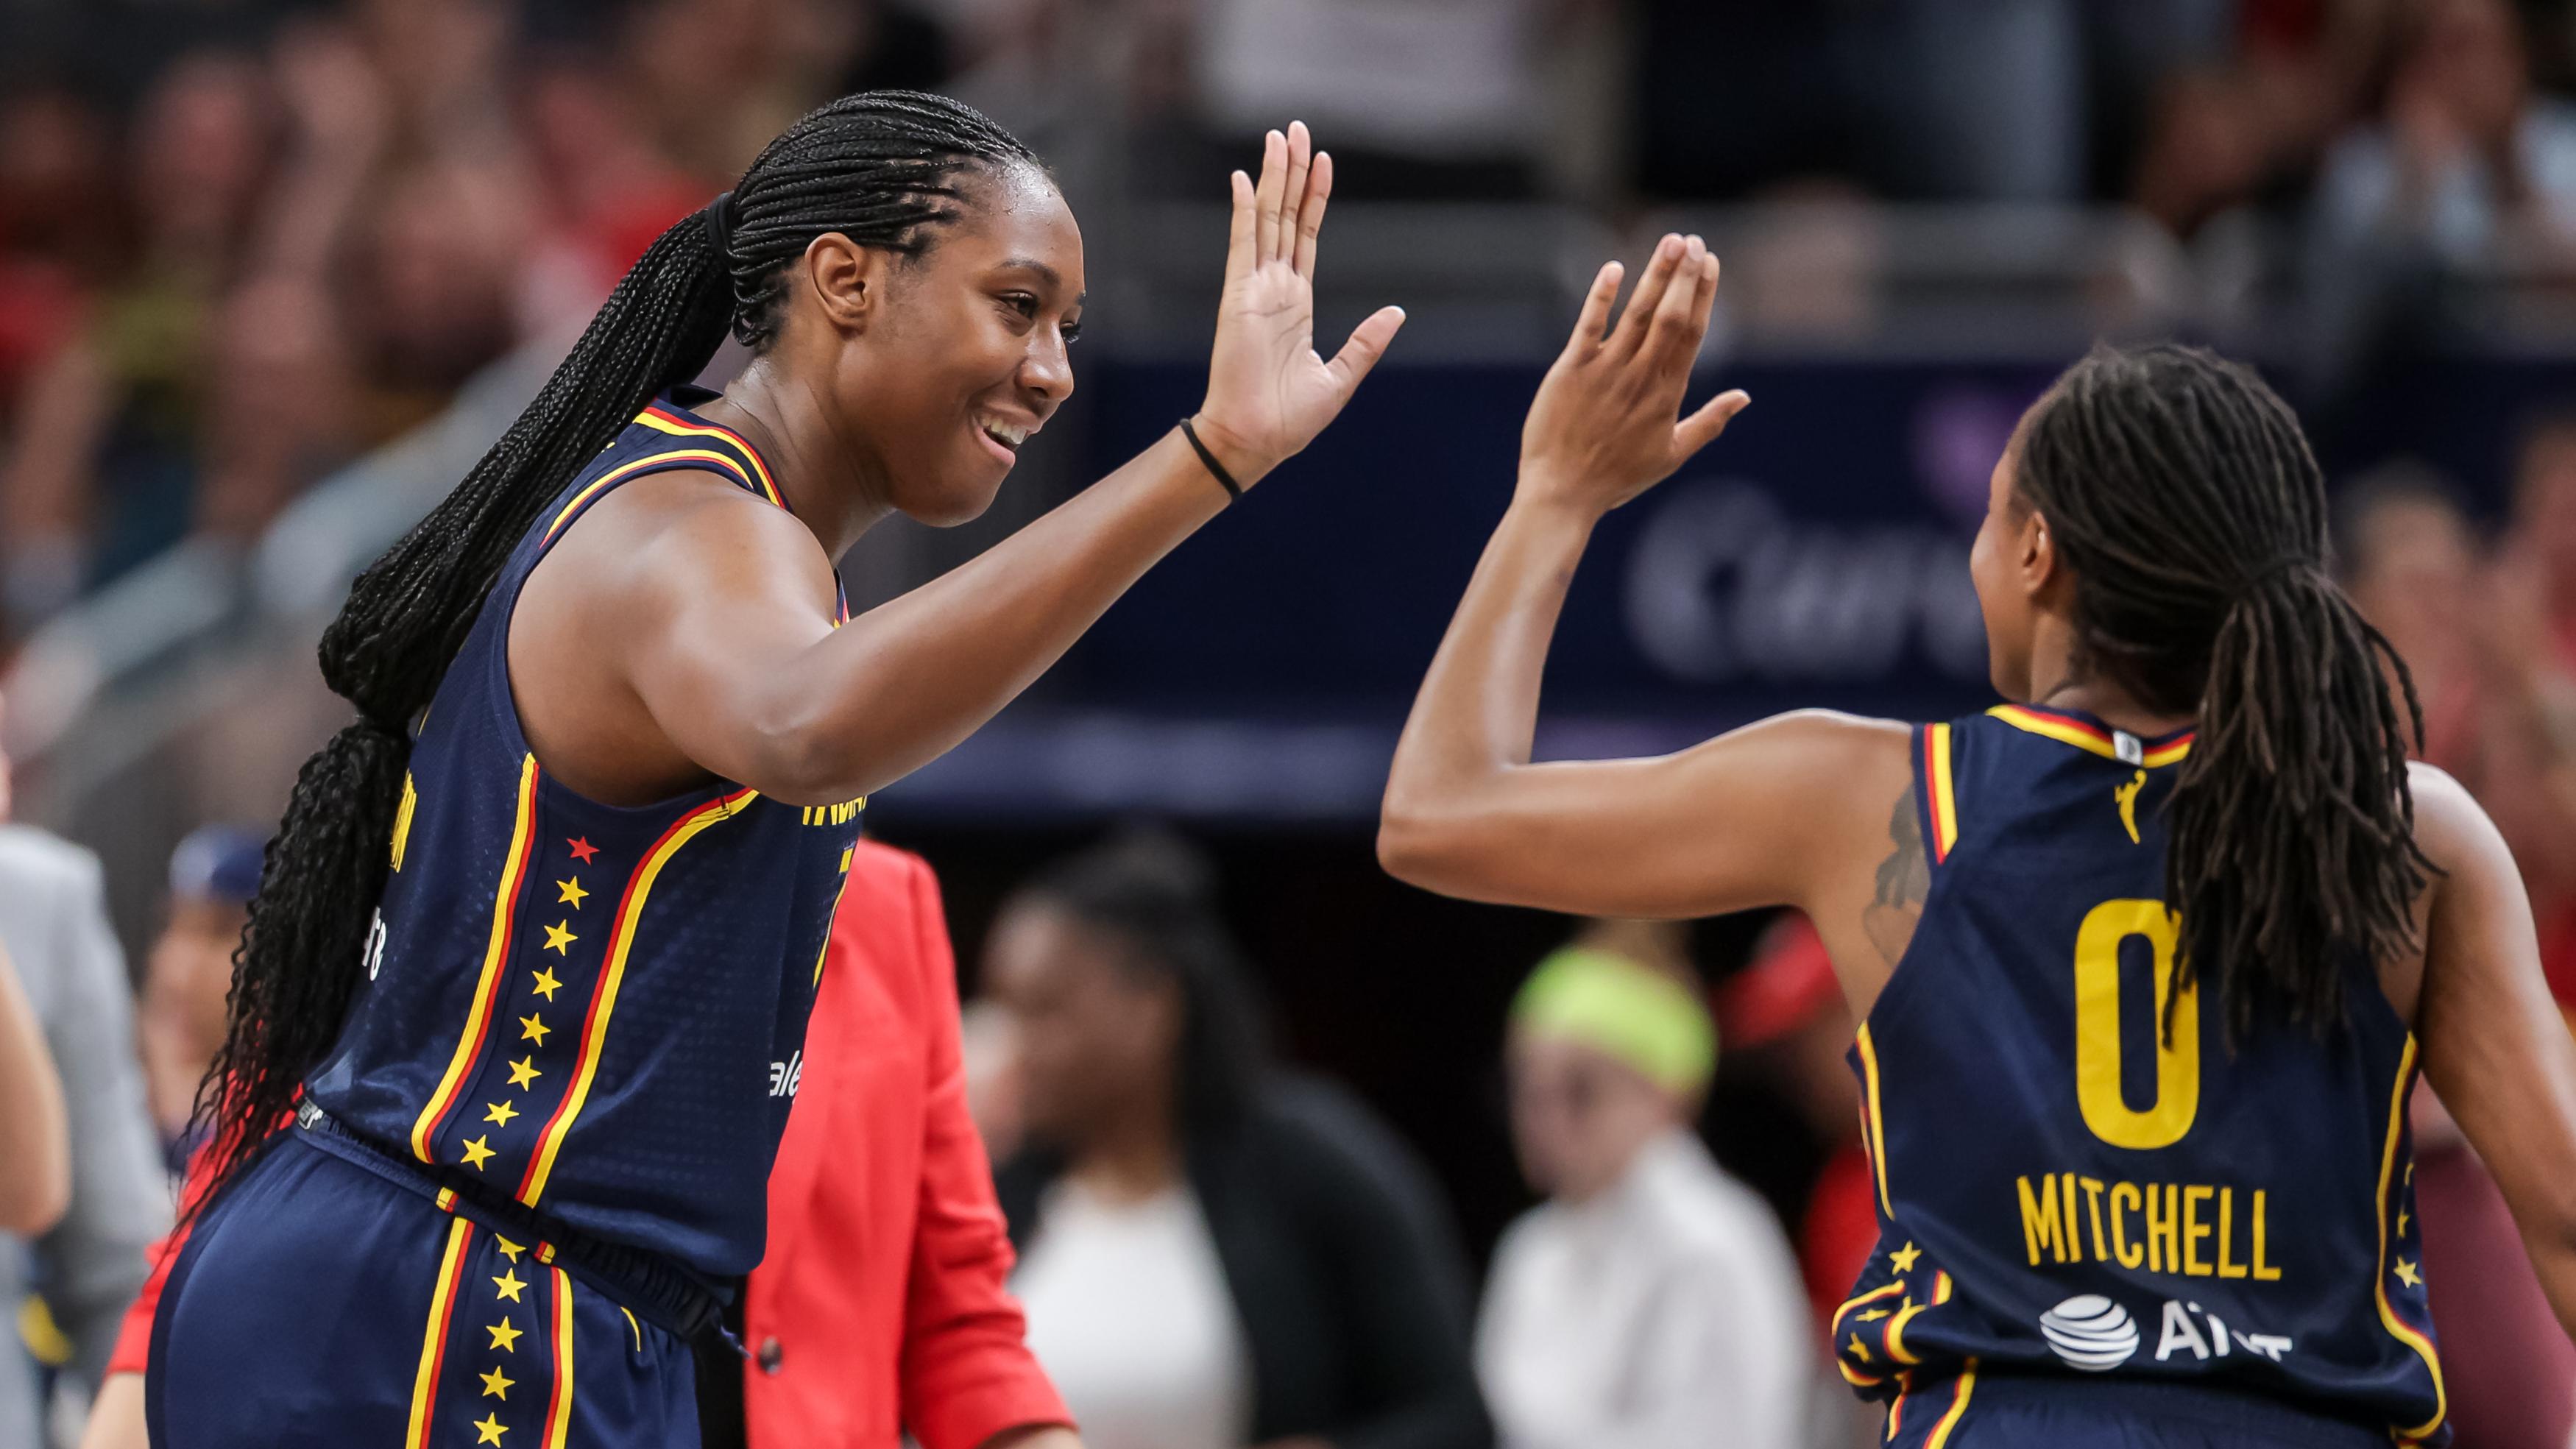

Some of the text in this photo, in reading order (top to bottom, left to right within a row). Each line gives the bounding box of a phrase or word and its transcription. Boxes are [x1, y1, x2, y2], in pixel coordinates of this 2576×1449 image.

[2074, 899, 2200, 1149] 0
[2017, 1172, 2282, 1280] MITCHELL
[2154, 1300, 2293, 1362] ATT
